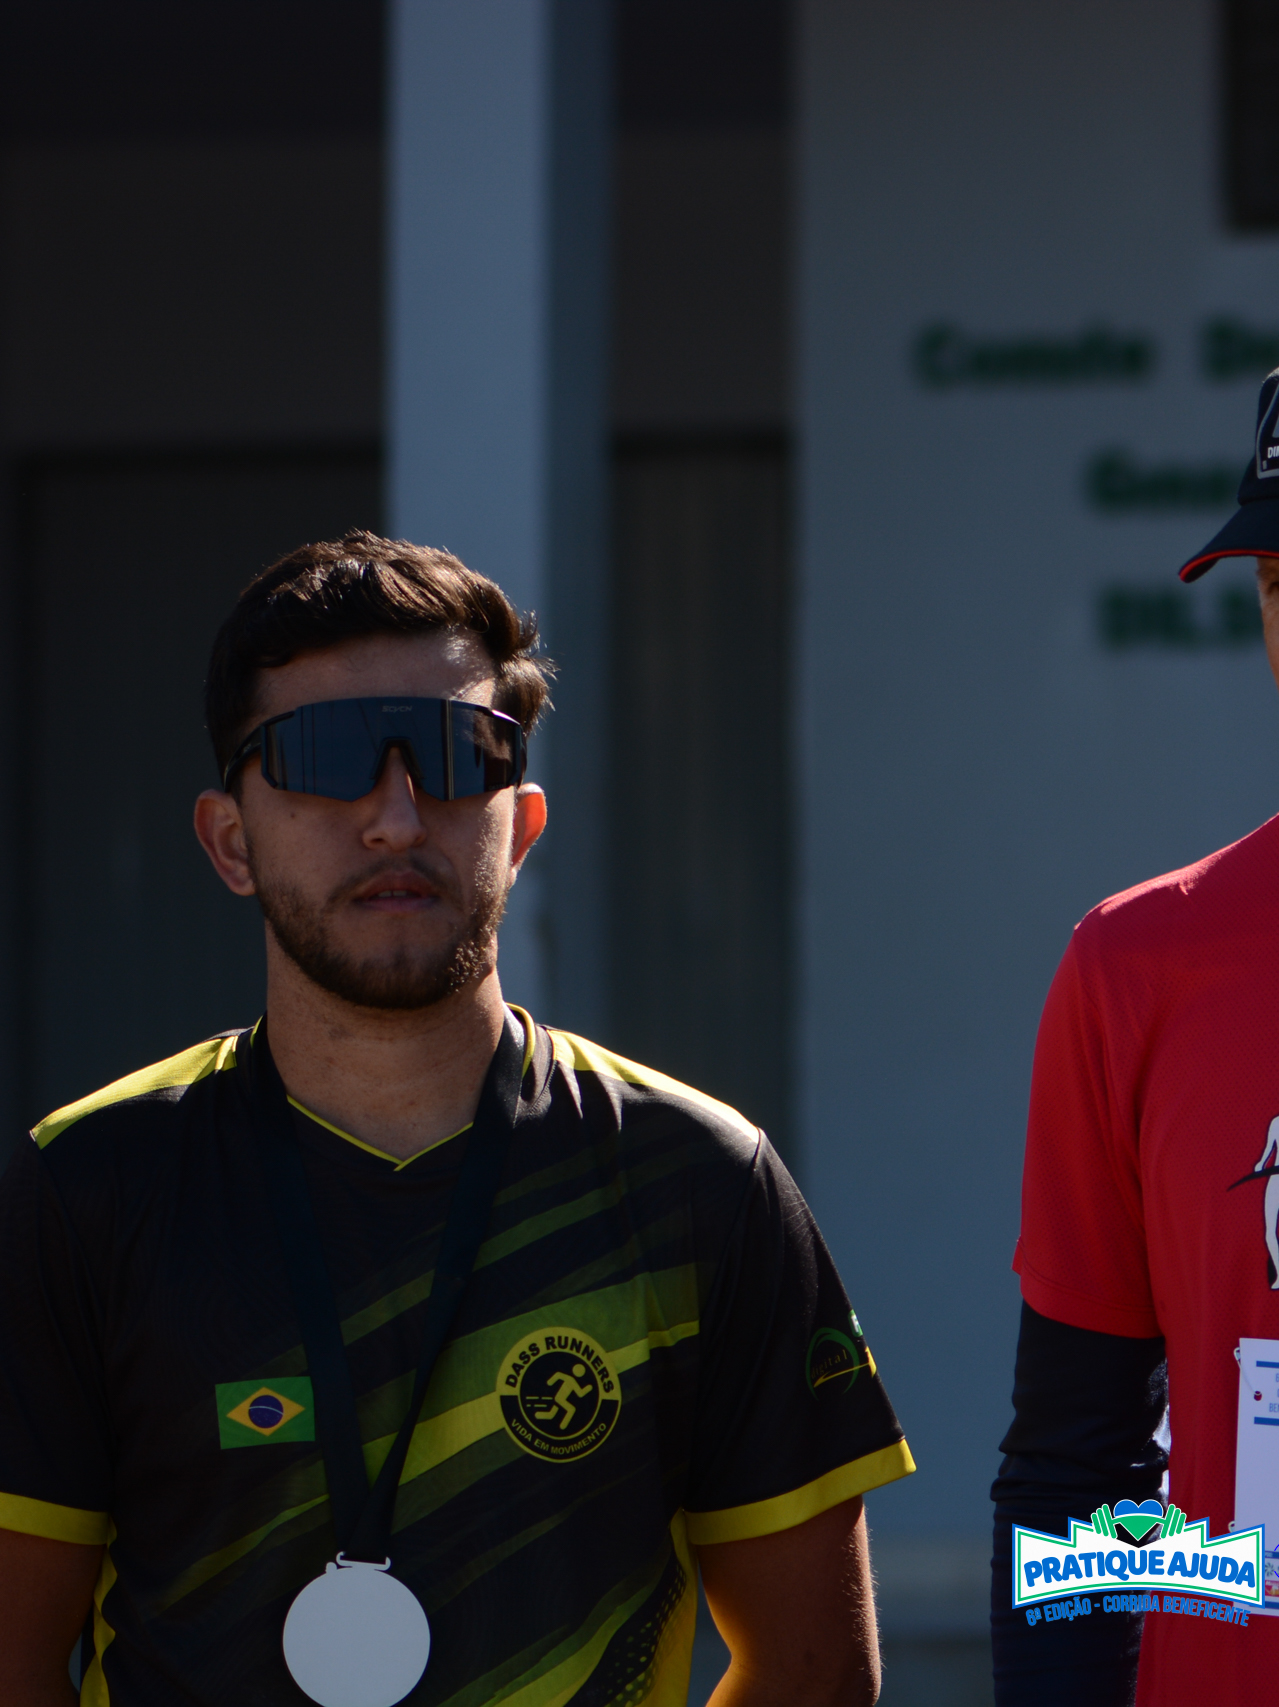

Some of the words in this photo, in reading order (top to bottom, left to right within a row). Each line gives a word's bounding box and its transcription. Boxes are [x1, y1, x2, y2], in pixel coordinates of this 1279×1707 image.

[505, 1342, 540, 1388] DASS
[544, 1335, 614, 1393] RUNNERS
[510, 1418, 533, 1442] VIDA
[533, 1437, 549, 1452] EM
[550, 1422, 607, 1455] MOVIMENTO
